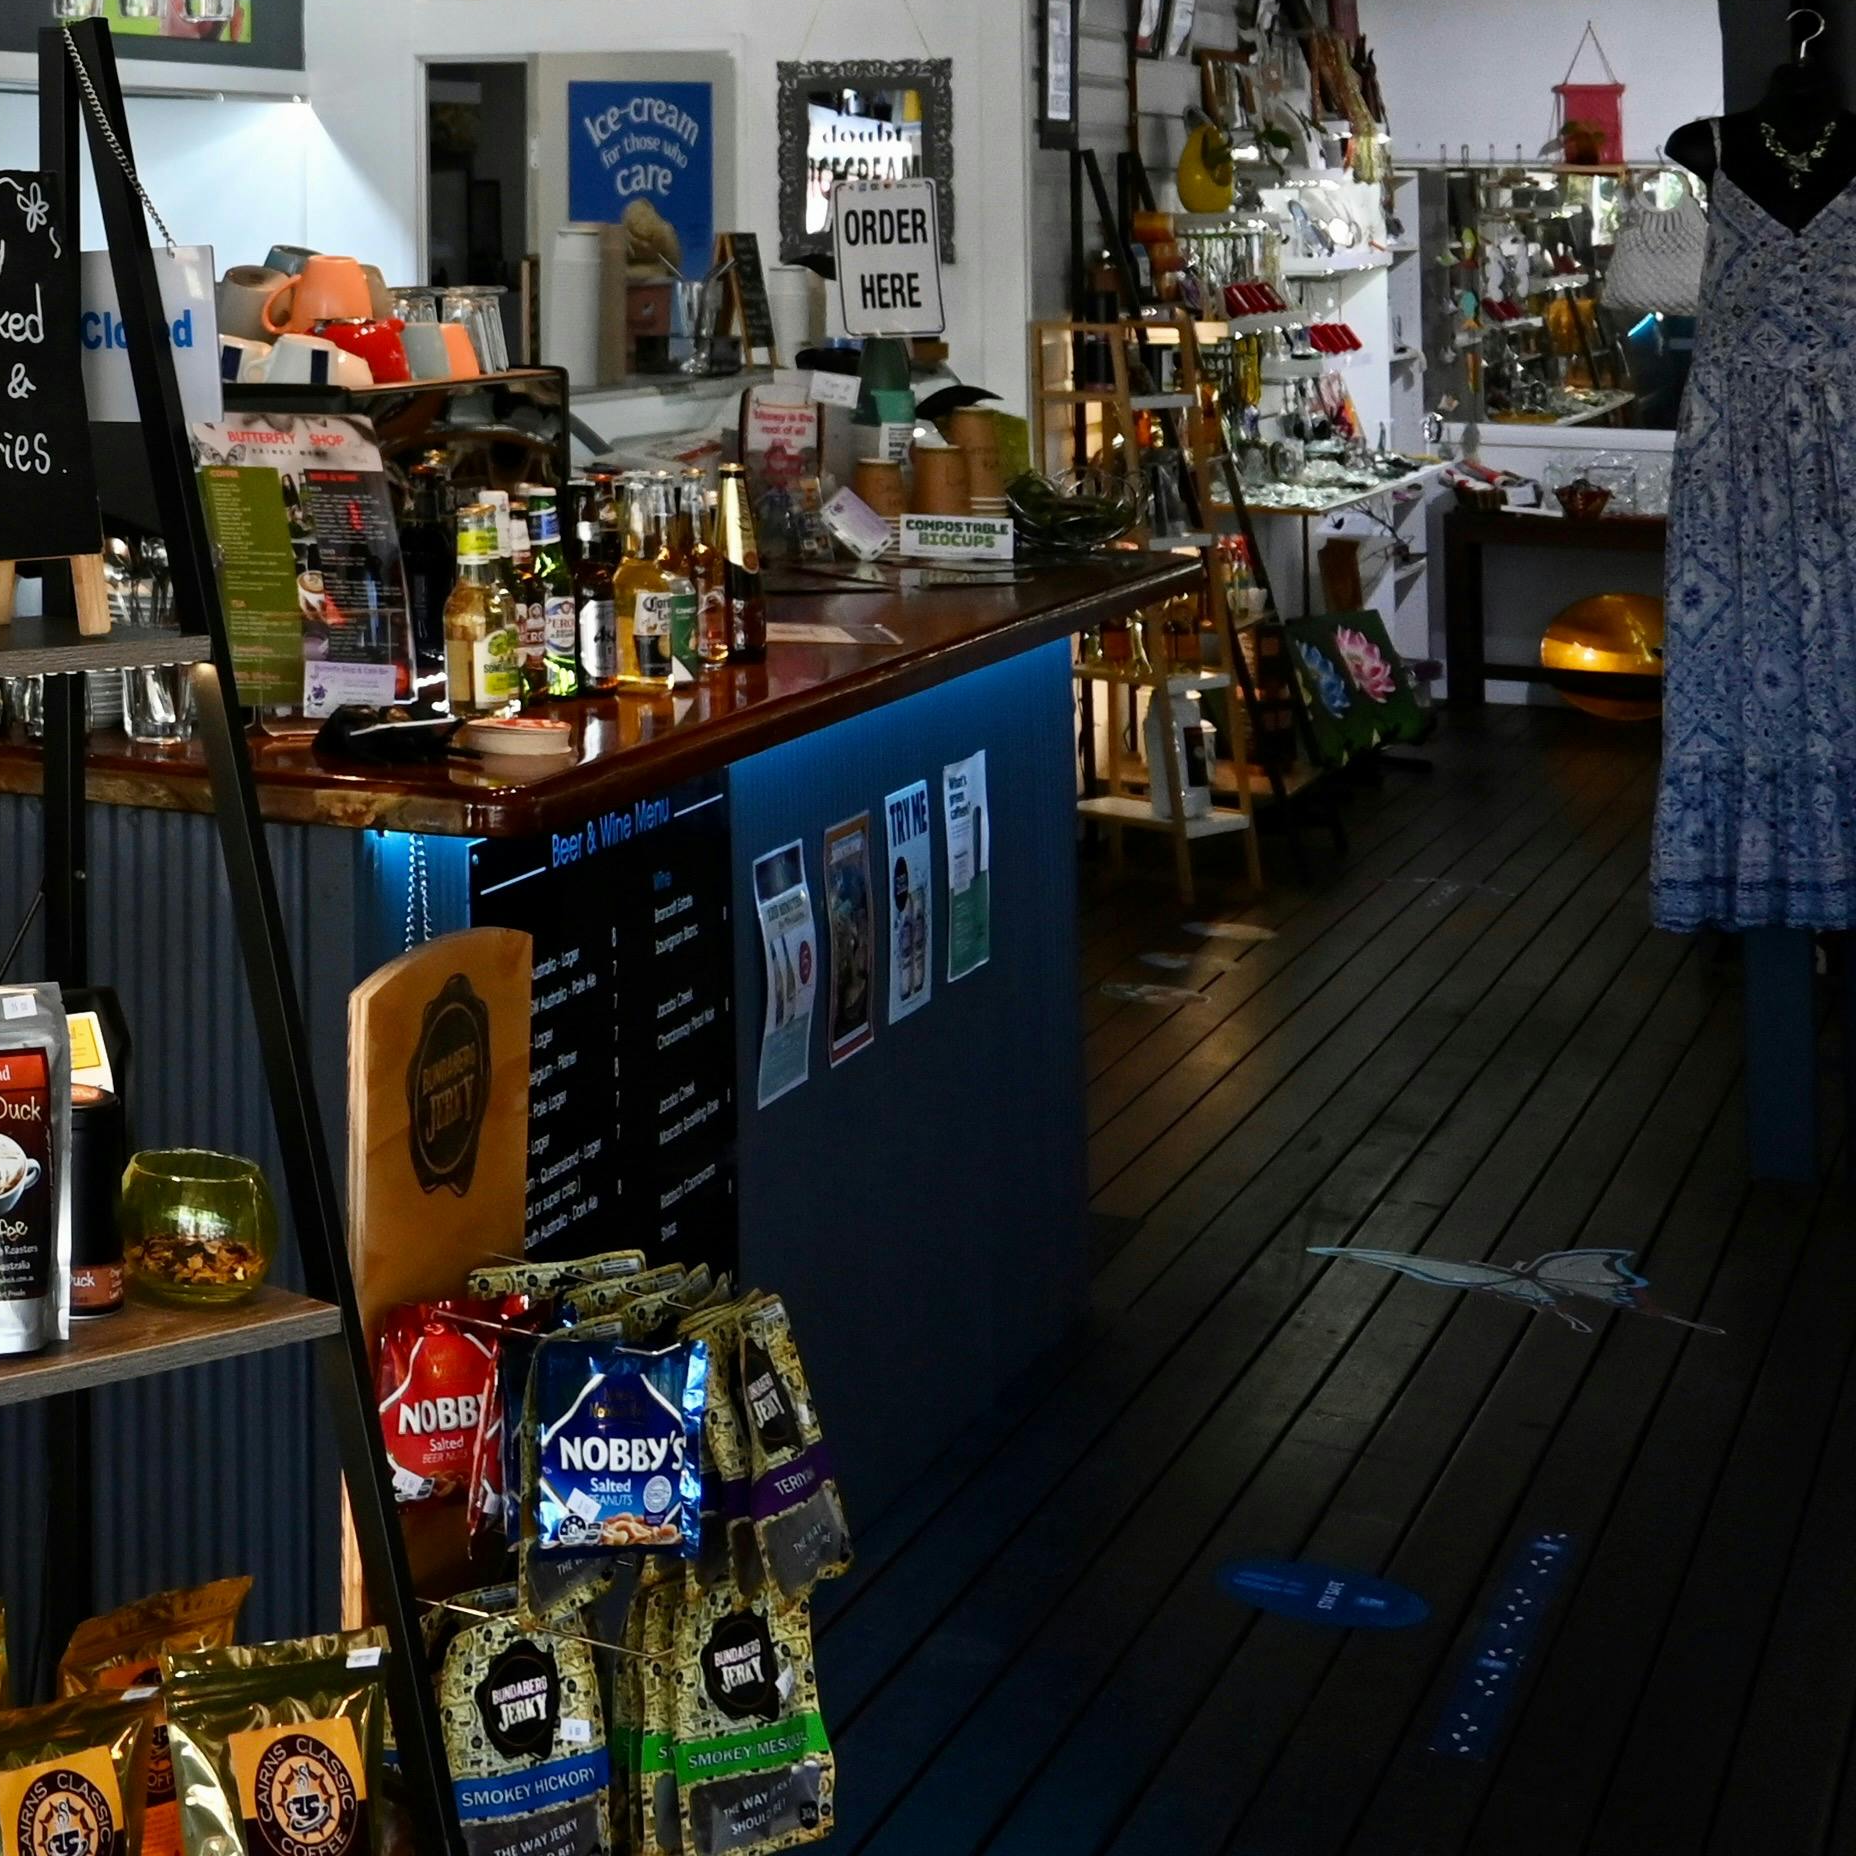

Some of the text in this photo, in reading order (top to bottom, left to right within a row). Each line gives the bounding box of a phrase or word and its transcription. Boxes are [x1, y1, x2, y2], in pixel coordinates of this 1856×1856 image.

[584, 94, 699, 149] Ice-cream
[601, 135, 689, 167] for those who
[616, 163, 673, 197] care
[844, 208, 928, 246] ORDER
[860, 272, 921, 310] HERE
[7, 364, 36, 397] &
[227, 430, 344, 446] BUTTERFLY SHOP
[905, 519, 1009, 538] COMPOSTABLE
[917, 533, 996, 548] BIOCUPS
[552, 796, 670, 868] Beer & Wine Menu
[890, 787, 928, 847] TRY ME
[560, 1431, 686, 1472] NOBBY'S
[590, 1478, 631, 1494] Salted
[492, 1675, 548, 1706] BUNDABERG
[498, 1694, 547, 1733] JERKY
[255, 1737, 357, 1823] CAIRNS CLASSIC
[462, 1768, 596, 1808] SMOKEY HICKORY
